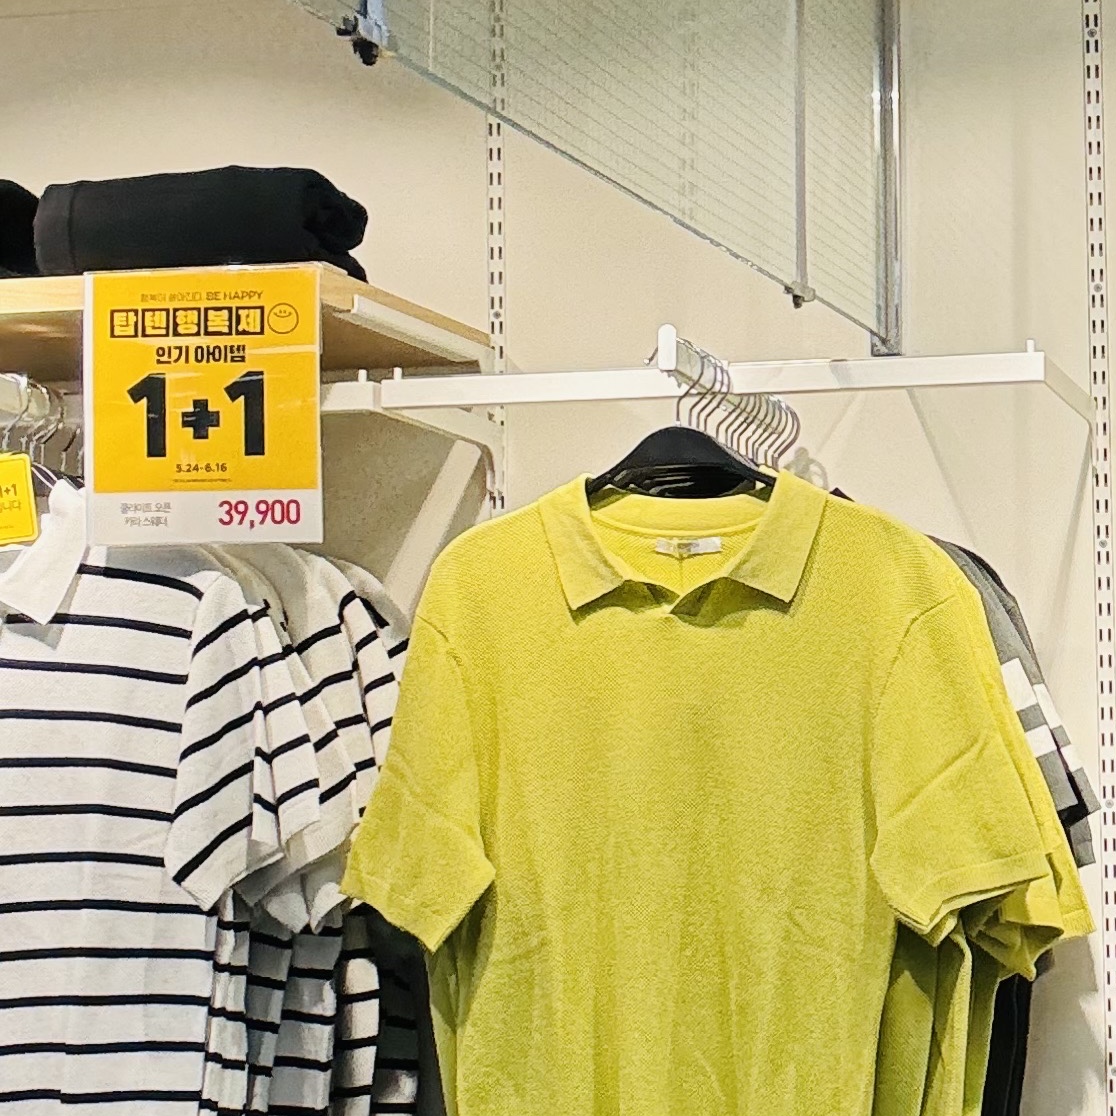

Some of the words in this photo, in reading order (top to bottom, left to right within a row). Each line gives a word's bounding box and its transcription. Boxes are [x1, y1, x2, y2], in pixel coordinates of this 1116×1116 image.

[205, 290, 221, 301] BE
[223, 290, 264, 301] HAPPY
[155, 345, 190, 365] 인기
[194, 344, 246, 364] 아이템
[126, 370, 265, 458] 1+1
[217, 498, 301, 529] 39,900
